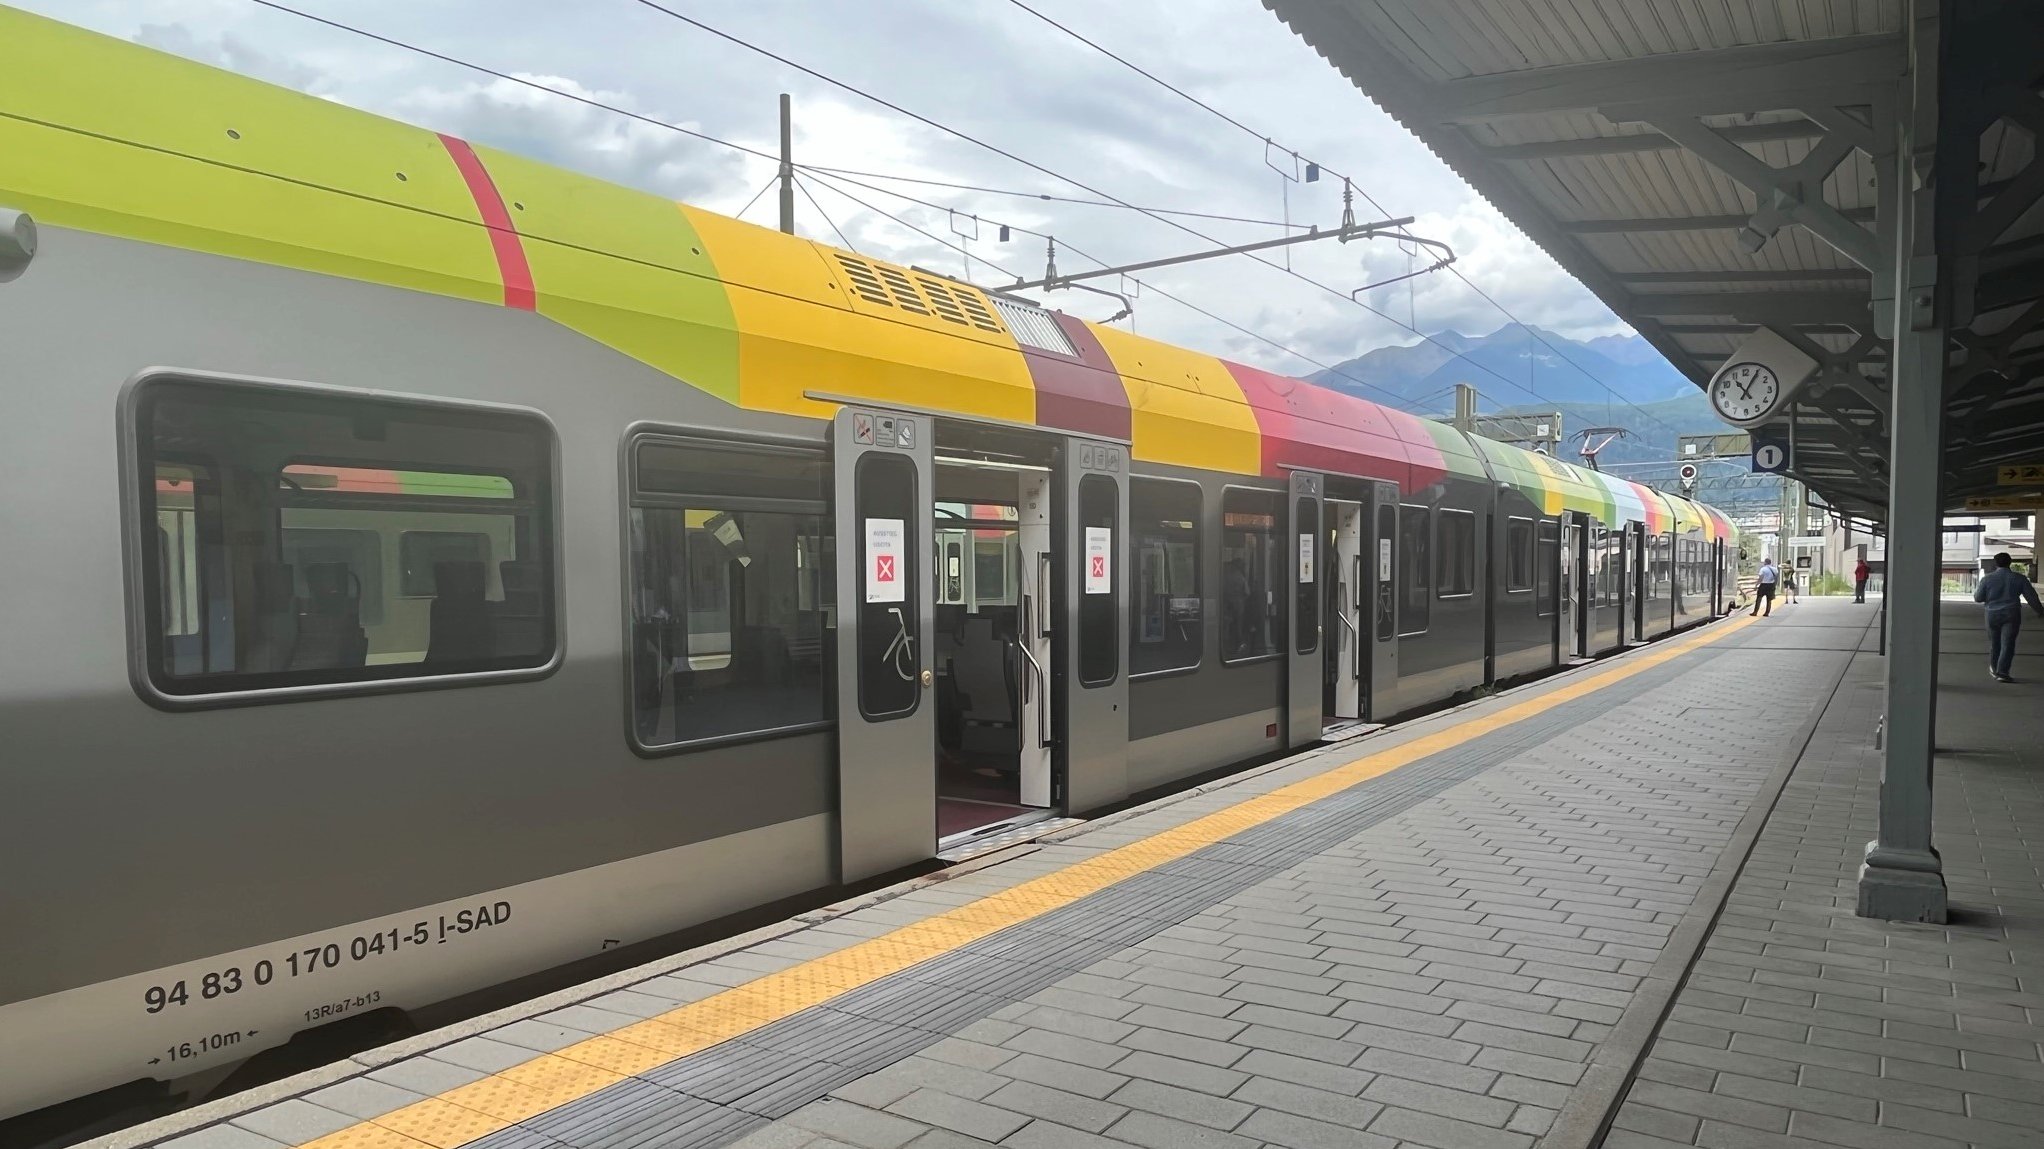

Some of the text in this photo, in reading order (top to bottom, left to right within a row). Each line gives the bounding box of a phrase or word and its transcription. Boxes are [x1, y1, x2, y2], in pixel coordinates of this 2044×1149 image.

[1733, 372, 1738, 380] 11
[1742, 368, 1750, 377] 12
[1763, 375, 1768, 384] 2
[1723, 381, 1731, 389] 10
[1767, 386, 1773, 394] 3
[1720, 391, 1726, 399] 9
[1763, 396, 1769, 404] 4
[1724, 401, 1730, 409] 8
[1754, 404, 1760, 413] 5
[1733, 407, 1738, 415] 7
[1743, 408, 1749, 416] 6
[1765, 449, 1773, 465] 1
[1800, 575, 1808, 586] T
[144, 901, 511, 1014] 94 83 0 170 041-5 I-SAD
[304, 990, 381, 1022] 13R/a7-b13
[167, 1030, 241, 1062] 16,10m
